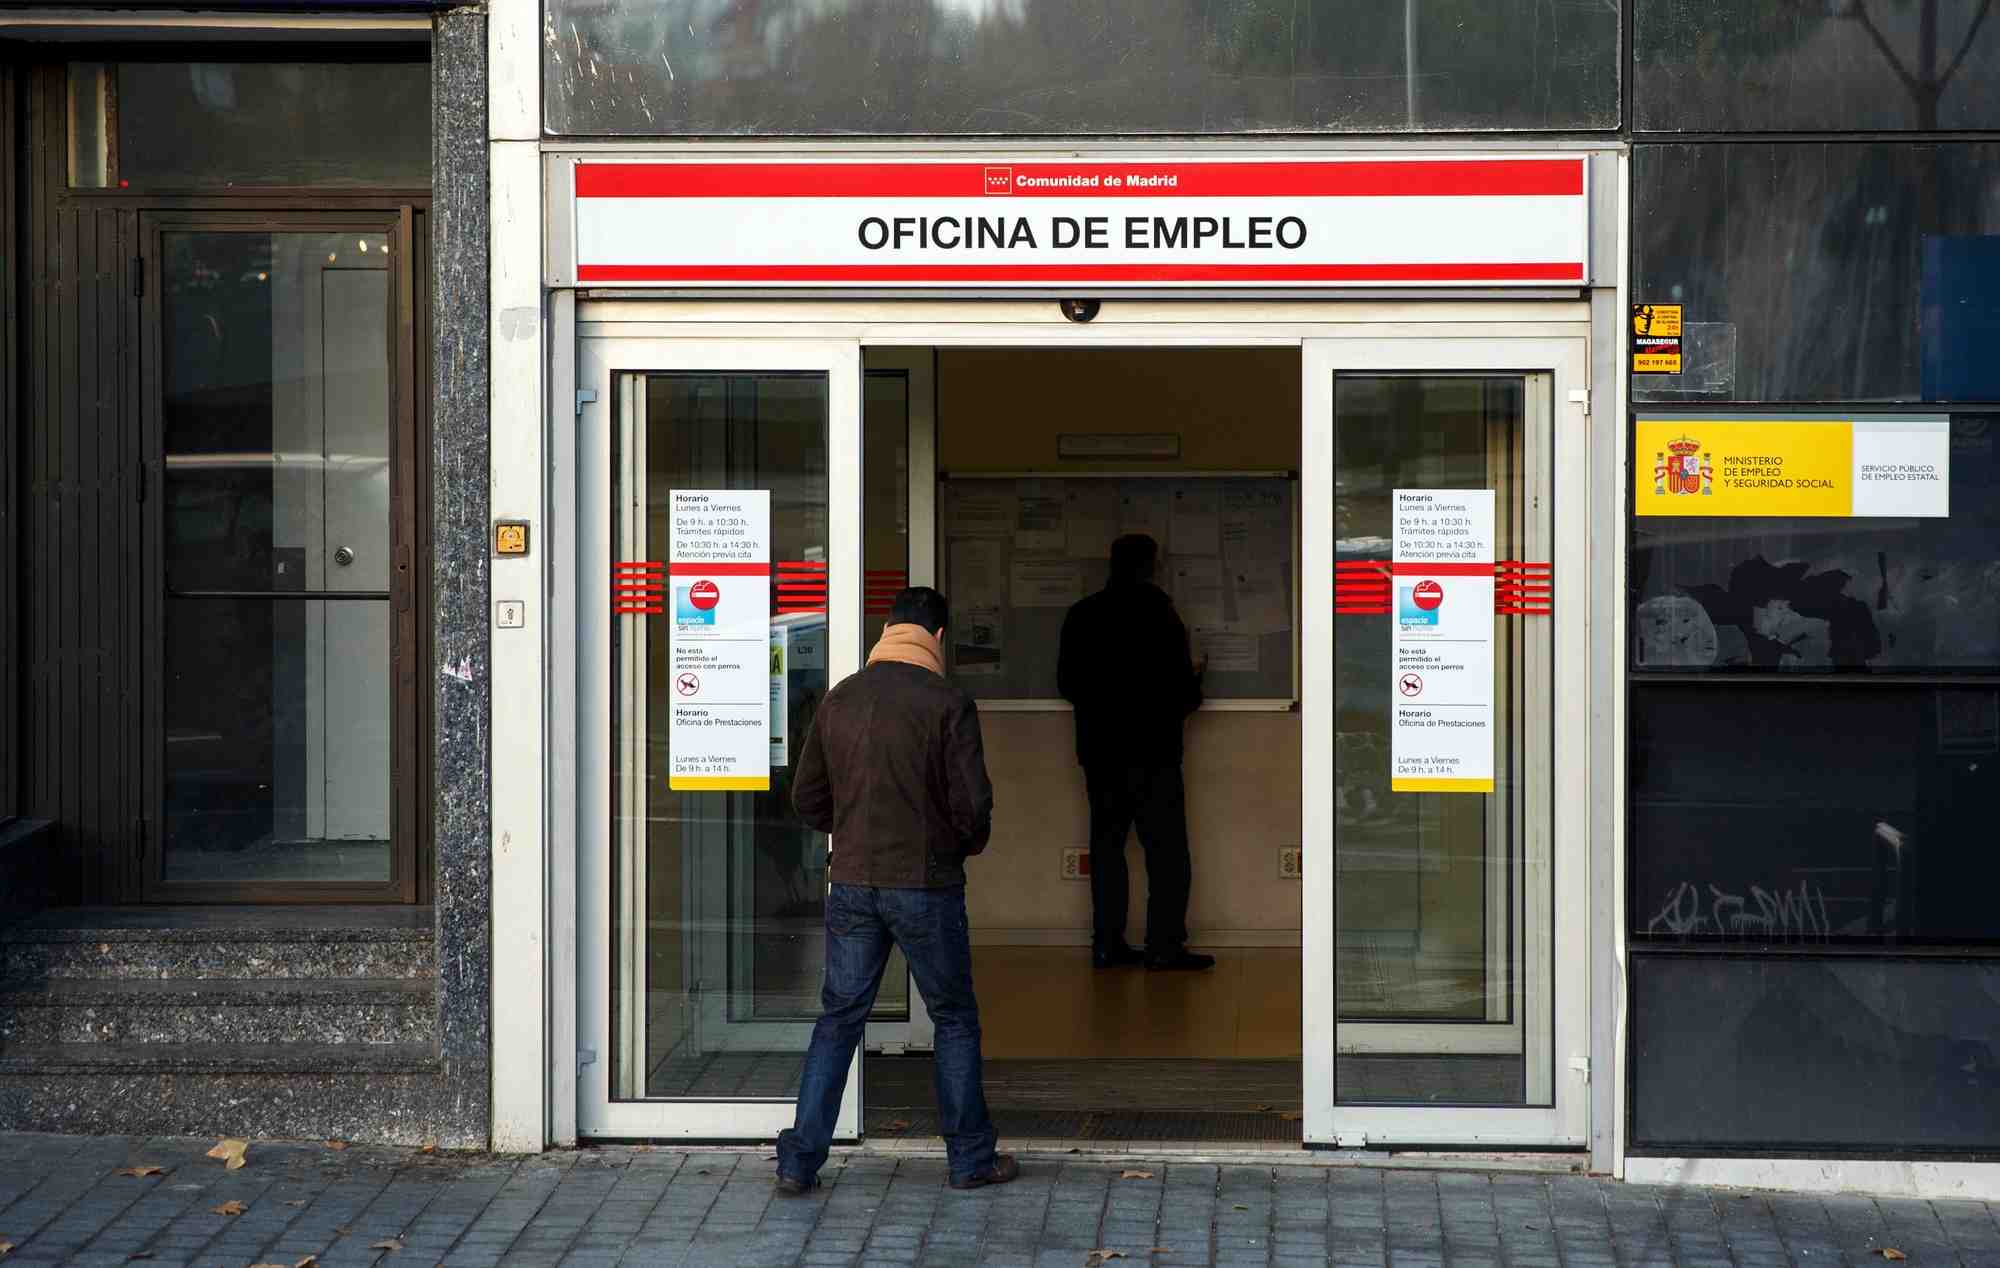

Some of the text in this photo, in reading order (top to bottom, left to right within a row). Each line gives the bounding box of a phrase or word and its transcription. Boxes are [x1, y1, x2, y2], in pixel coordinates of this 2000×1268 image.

[1016, 174, 1178, 189] Comunidad de Madrid
[858, 216, 1308, 250] OFICINA DE EMPLEO
[1723, 456, 1783, 466] MINISTERIO
[1723, 468, 1782, 477] DE EMPLEO
[1861, 464, 1897, 473] SERVICIO
[1861, 473, 1940, 481] DE EMPLEO ESTATAL
[1723, 479, 1835, 489] Y SEGURIDAD SOCIAL
[676, 495, 709, 503] Horario
[1399, 494, 1433, 502] Horario
[676, 504, 701, 512] Lunes
[711, 504, 742, 512] Viernes
[1399, 504, 1425, 512] Lunes
[1434, 504, 1467, 512] Viernes
[676, 518, 688, 526] De
[717, 518, 739, 526] 10:30
[1400, 518, 1411, 526] De
[1440, 518, 1463, 526] 10:30
[676, 540, 688, 549] De
[690, 540, 712, 549] 10:30
[730, 540, 751, 549] 14:30
[1400, 540, 1411, 549] De
[1413, 540, 1435, 549] 10:30
[1453, 540, 1476, 549] 14:30
[712, 552, 736, 560] previa
[738, 550, 752, 559] cita
[676, 709, 709, 717] Horario
[1399, 710, 1432, 718] Horario
[676, 718, 763, 727] Oficina de Prestaciones
[1398, 719, 1487, 728] Oficina de Prestaciones
[675, 755, 700, 764] Lunes
[707, 755, 737, 764] Viernes
[1398, 756, 1422, 765] Lunes
[1431, 756, 1460, 765] Viernes
[675, 765, 687, 773] De
[713, 765, 722, 773] 14
[1398, 766, 1410, 774] De
[1436, 766, 1445, 774] 14
